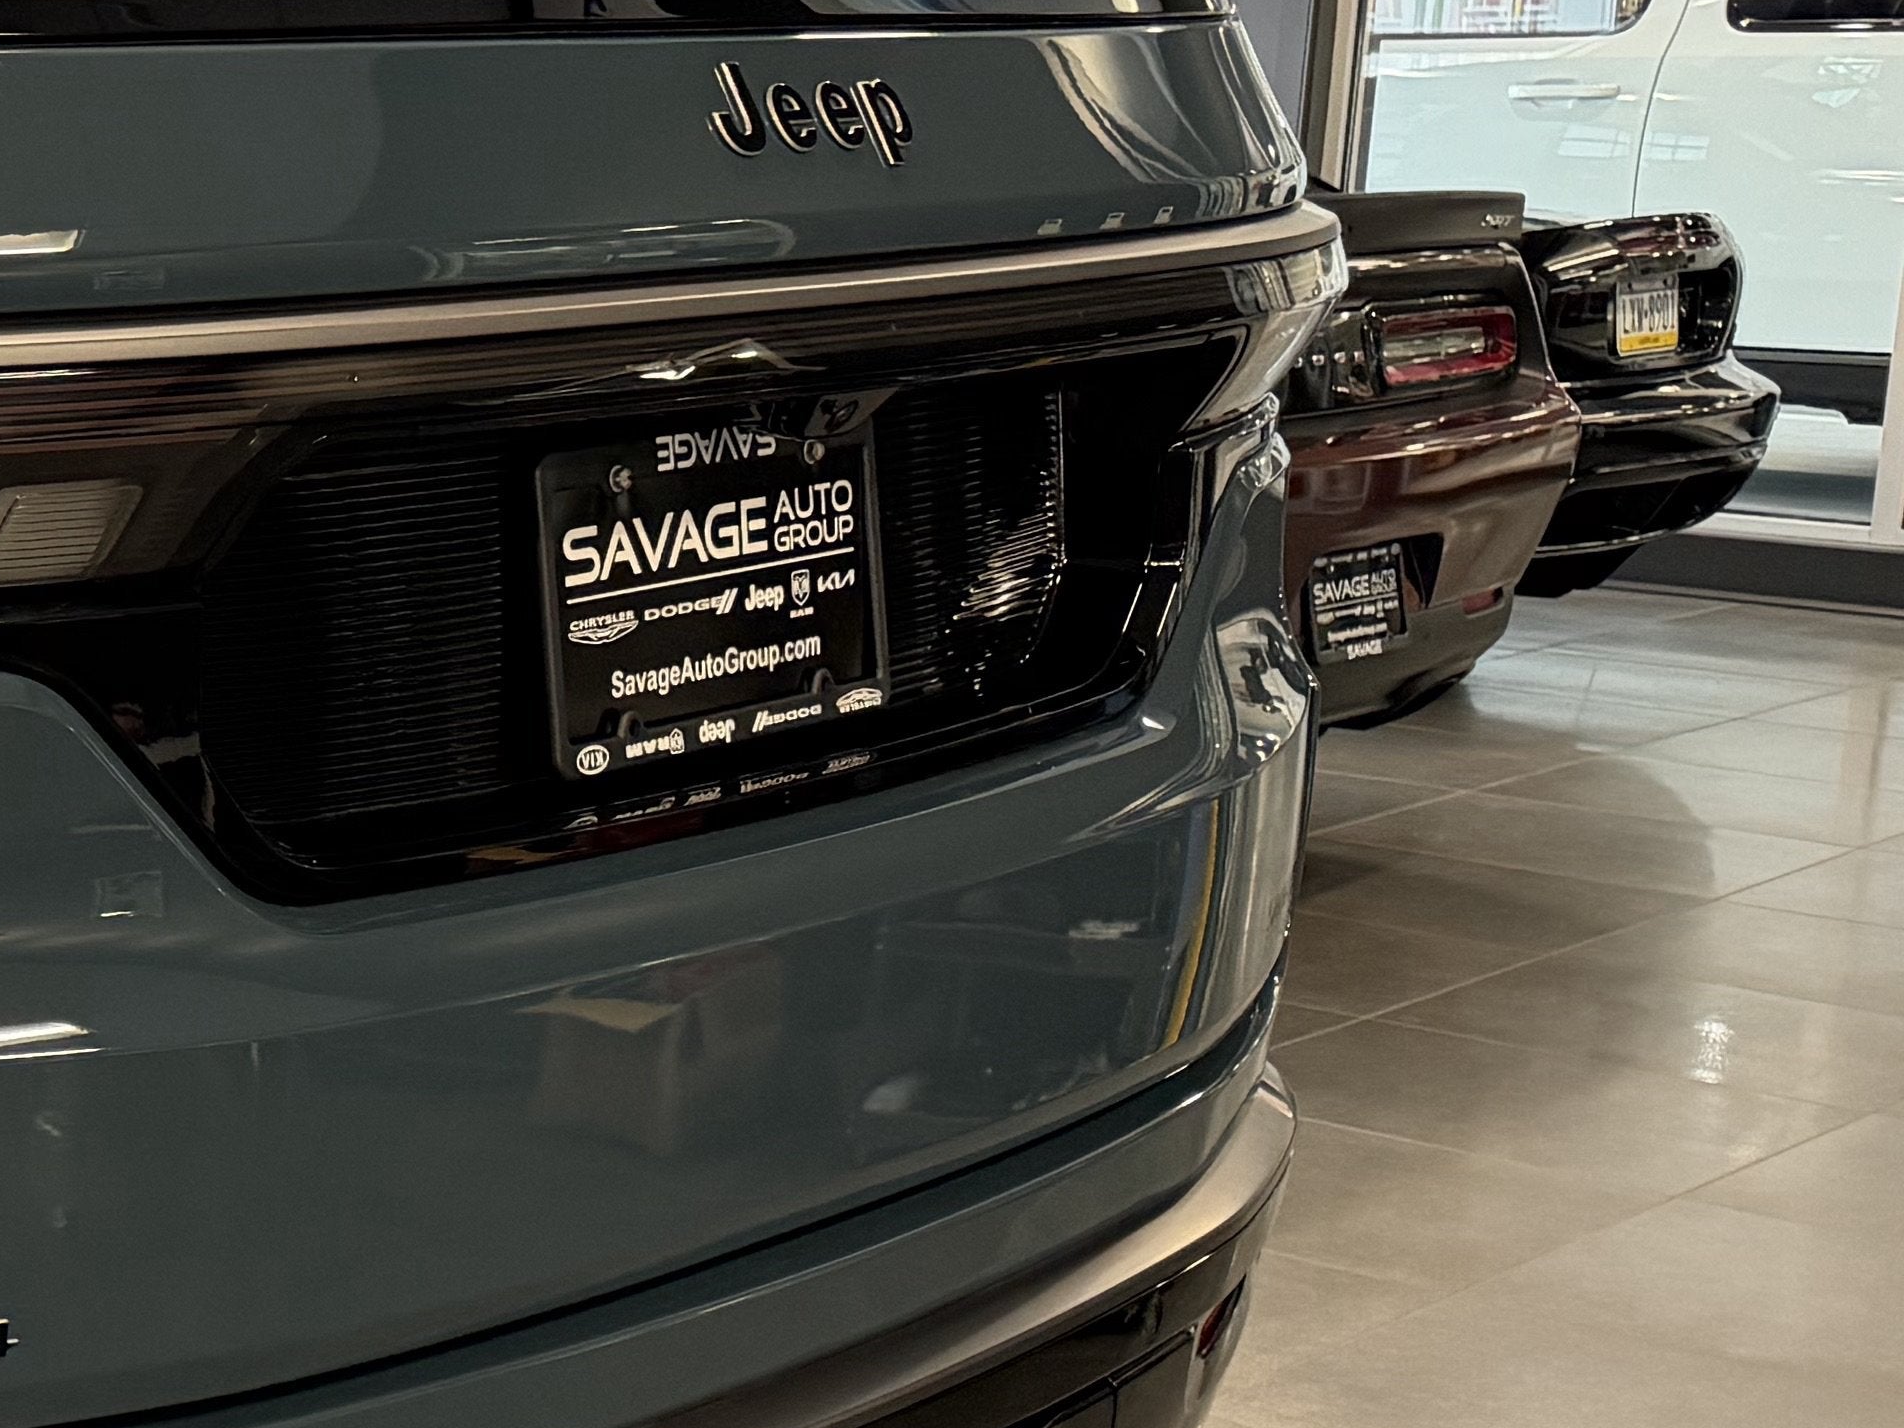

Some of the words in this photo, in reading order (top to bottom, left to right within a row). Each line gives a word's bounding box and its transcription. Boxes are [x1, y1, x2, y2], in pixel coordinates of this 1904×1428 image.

[706, 60, 914, 169] Jeep
[655, 425, 777, 472] SAVAGE
[772, 478, 854, 524] AUTO
[561, 495, 769, 588] SAVAGE
[773, 515, 855, 553] GROUP
[568, 609, 635, 632] CHRYSLER
[643, 593, 727, 621] DODGE
[743, 584, 785, 612] Jeep
[1312, 573, 1370, 605] SAVAGE
[611, 635, 822, 699] SavageAutoGroup.com
[698, 718, 736, 744] Jeep
[579, 748, 606, 771] KIA
